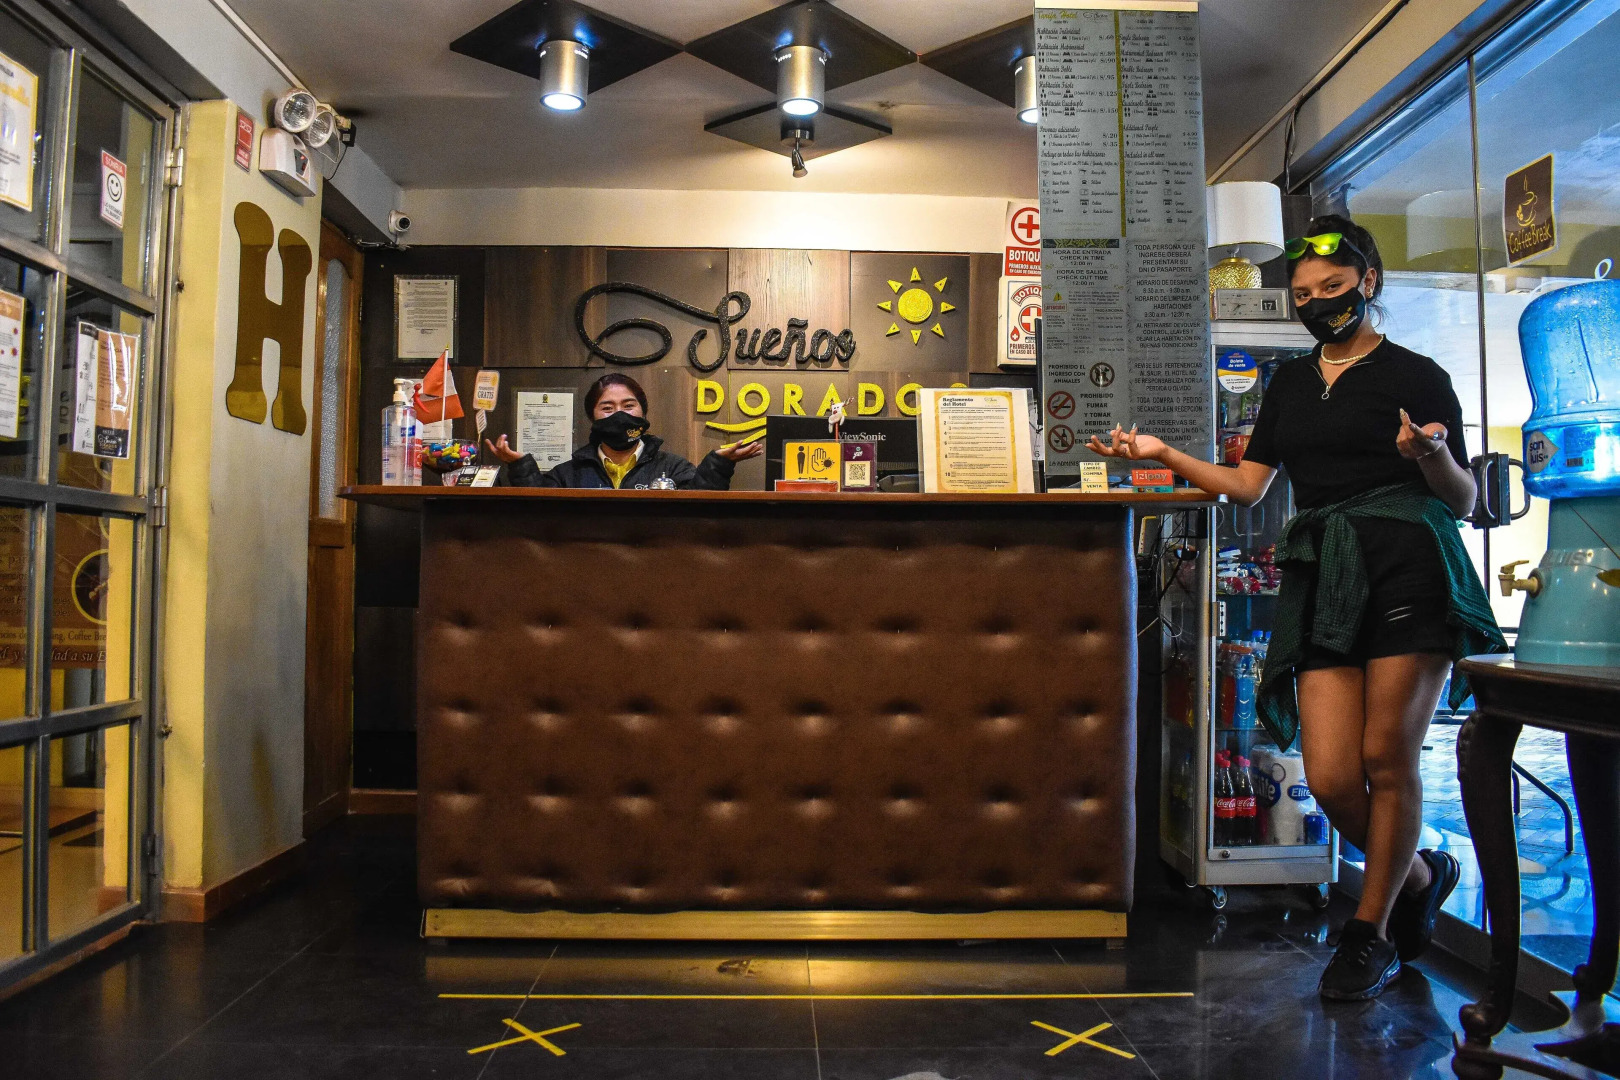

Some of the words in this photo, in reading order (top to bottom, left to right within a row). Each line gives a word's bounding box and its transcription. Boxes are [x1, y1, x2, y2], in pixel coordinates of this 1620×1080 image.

[1008, 249, 1040, 262] BOTIQU
[1014, 286, 1042, 302] BOTIQ
[697, 380, 968, 416] DORADO
[838, 432, 886, 441] ViewSonic
[1529, 440, 1544, 451] san
[1530, 452, 1544, 464] luis
[1136, 472, 1167, 482] izipay
[1292, 788, 1311, 797] Elite
